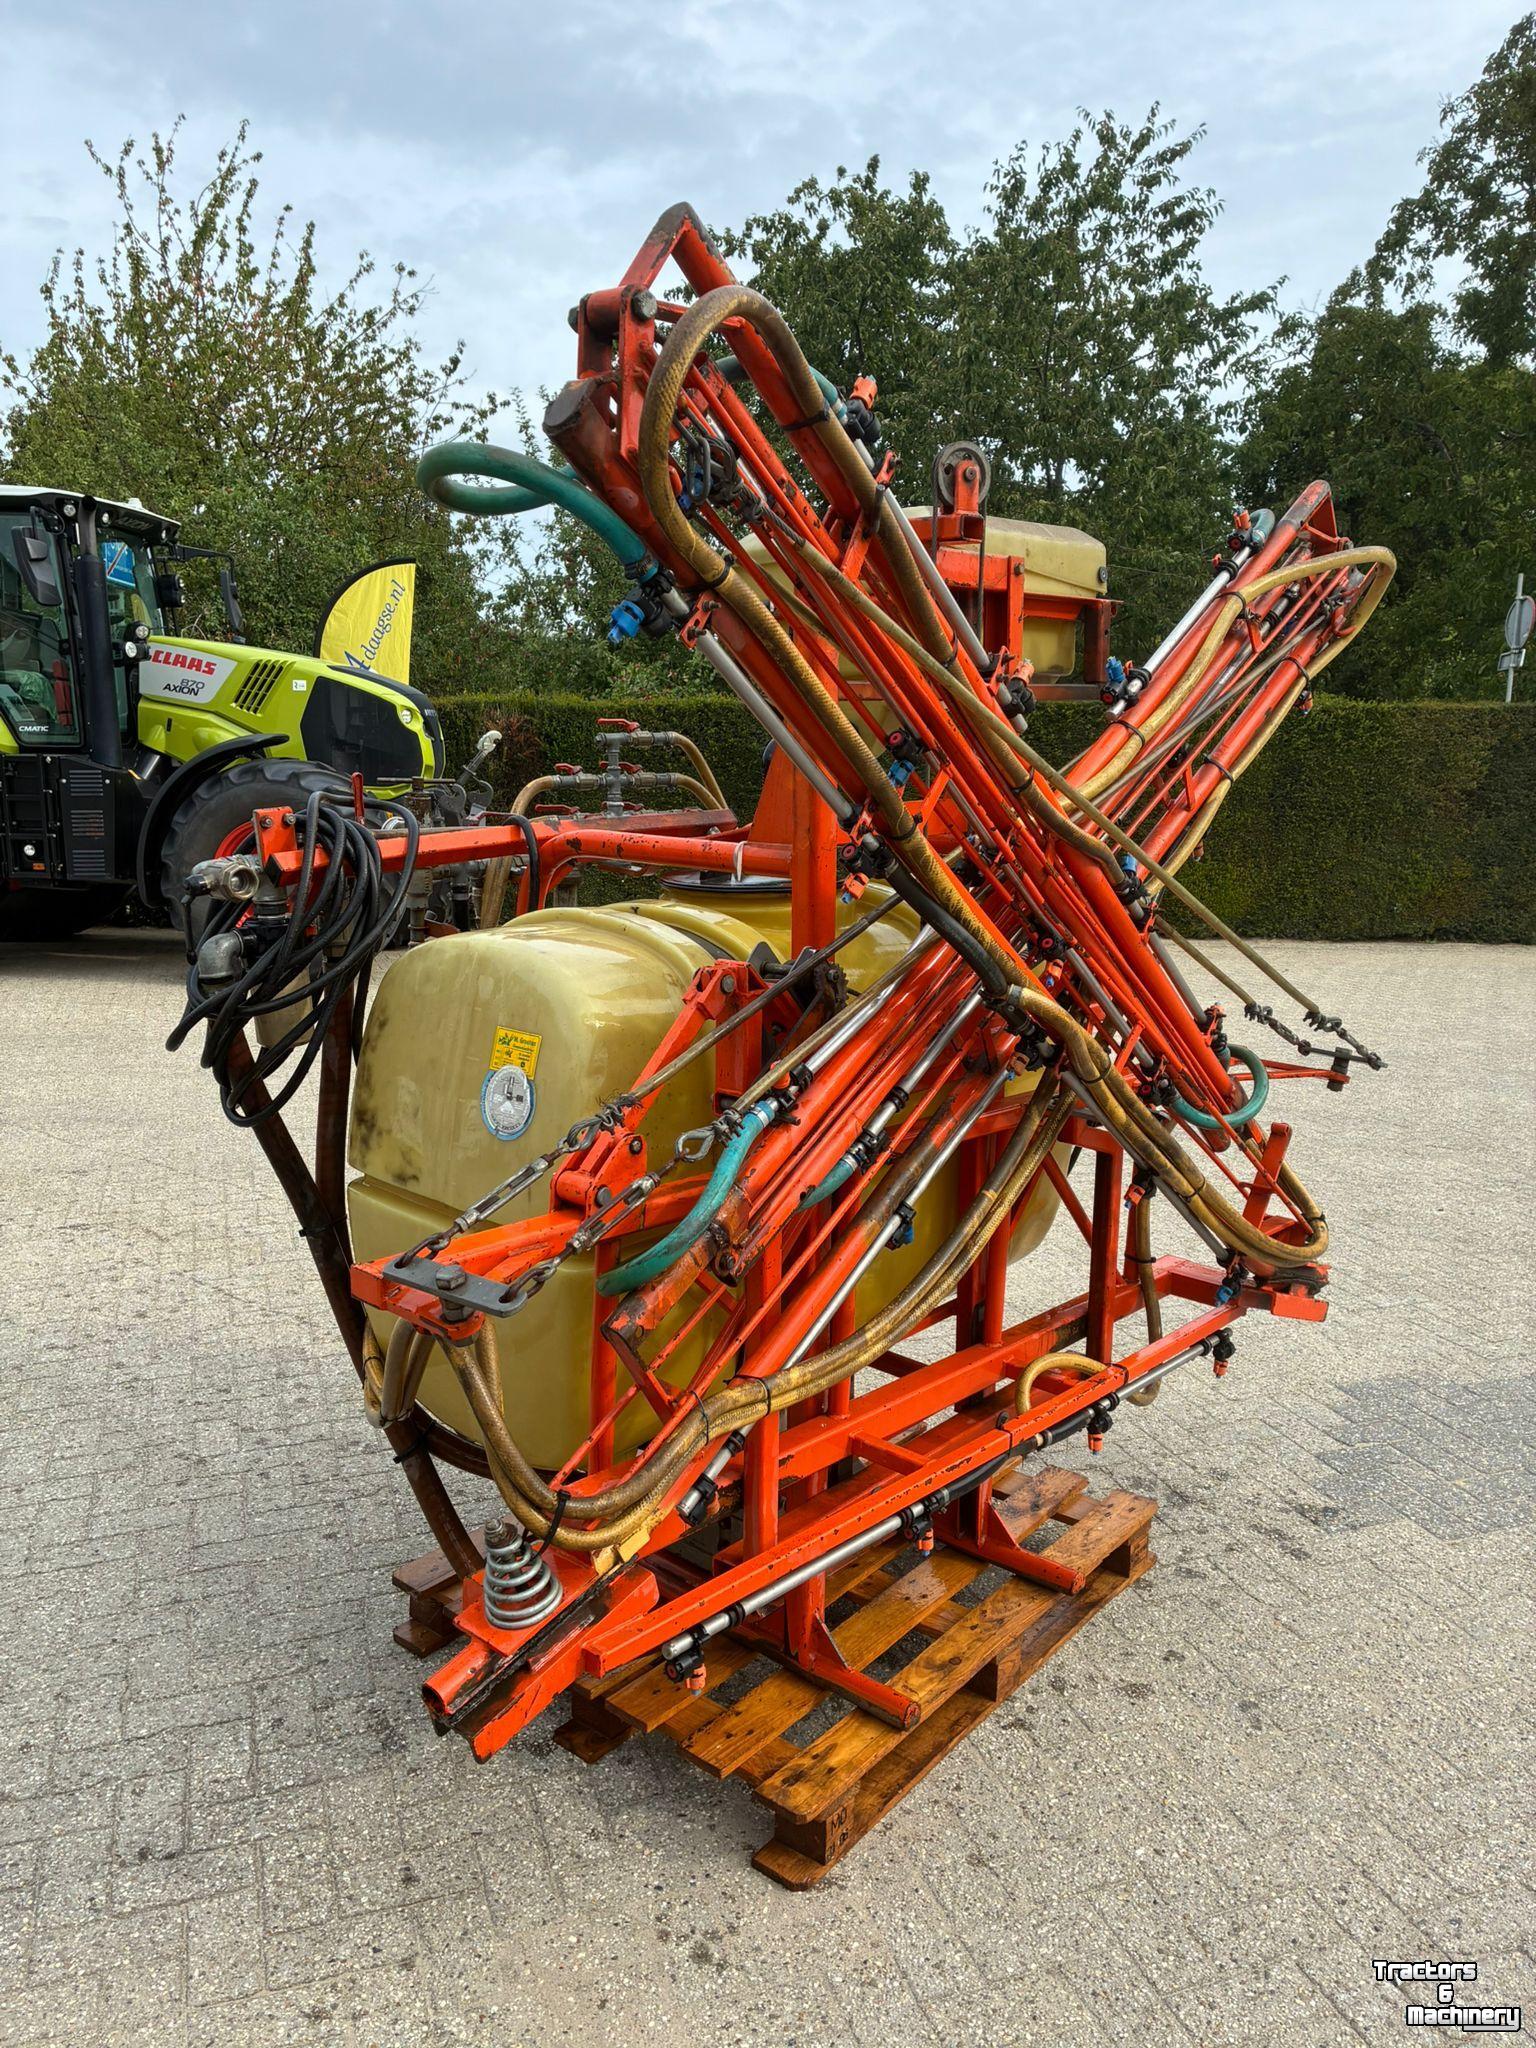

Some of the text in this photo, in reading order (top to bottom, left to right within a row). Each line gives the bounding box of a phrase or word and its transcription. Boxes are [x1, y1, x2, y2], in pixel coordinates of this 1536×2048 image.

[151, 649, 217, 676] CLAAS
[162, 683, 200, 696] AXION
[180, 678, 205, 690] 870
